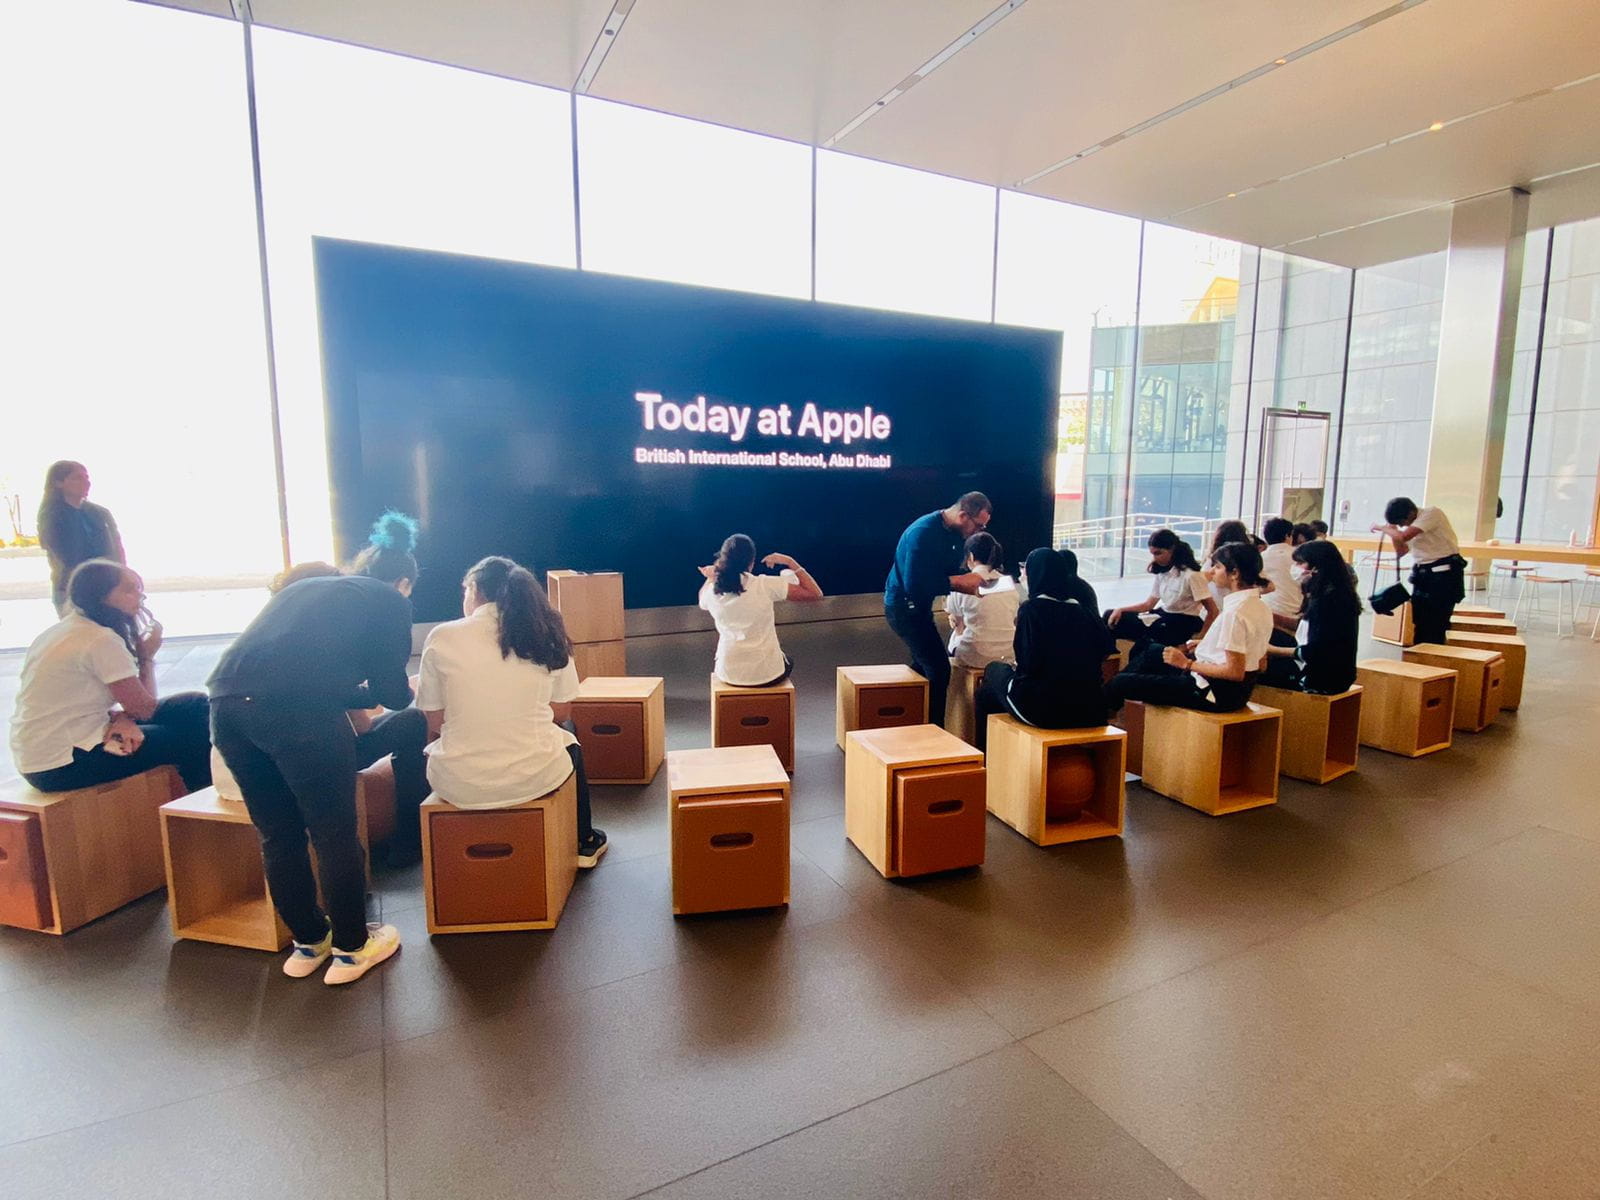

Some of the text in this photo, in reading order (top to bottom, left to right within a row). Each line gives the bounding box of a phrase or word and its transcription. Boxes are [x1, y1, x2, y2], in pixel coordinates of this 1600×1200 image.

[635, 392, 891, 444] Today at Apple
[634, 448, 892, 469] British International School, Abu Dhabi
